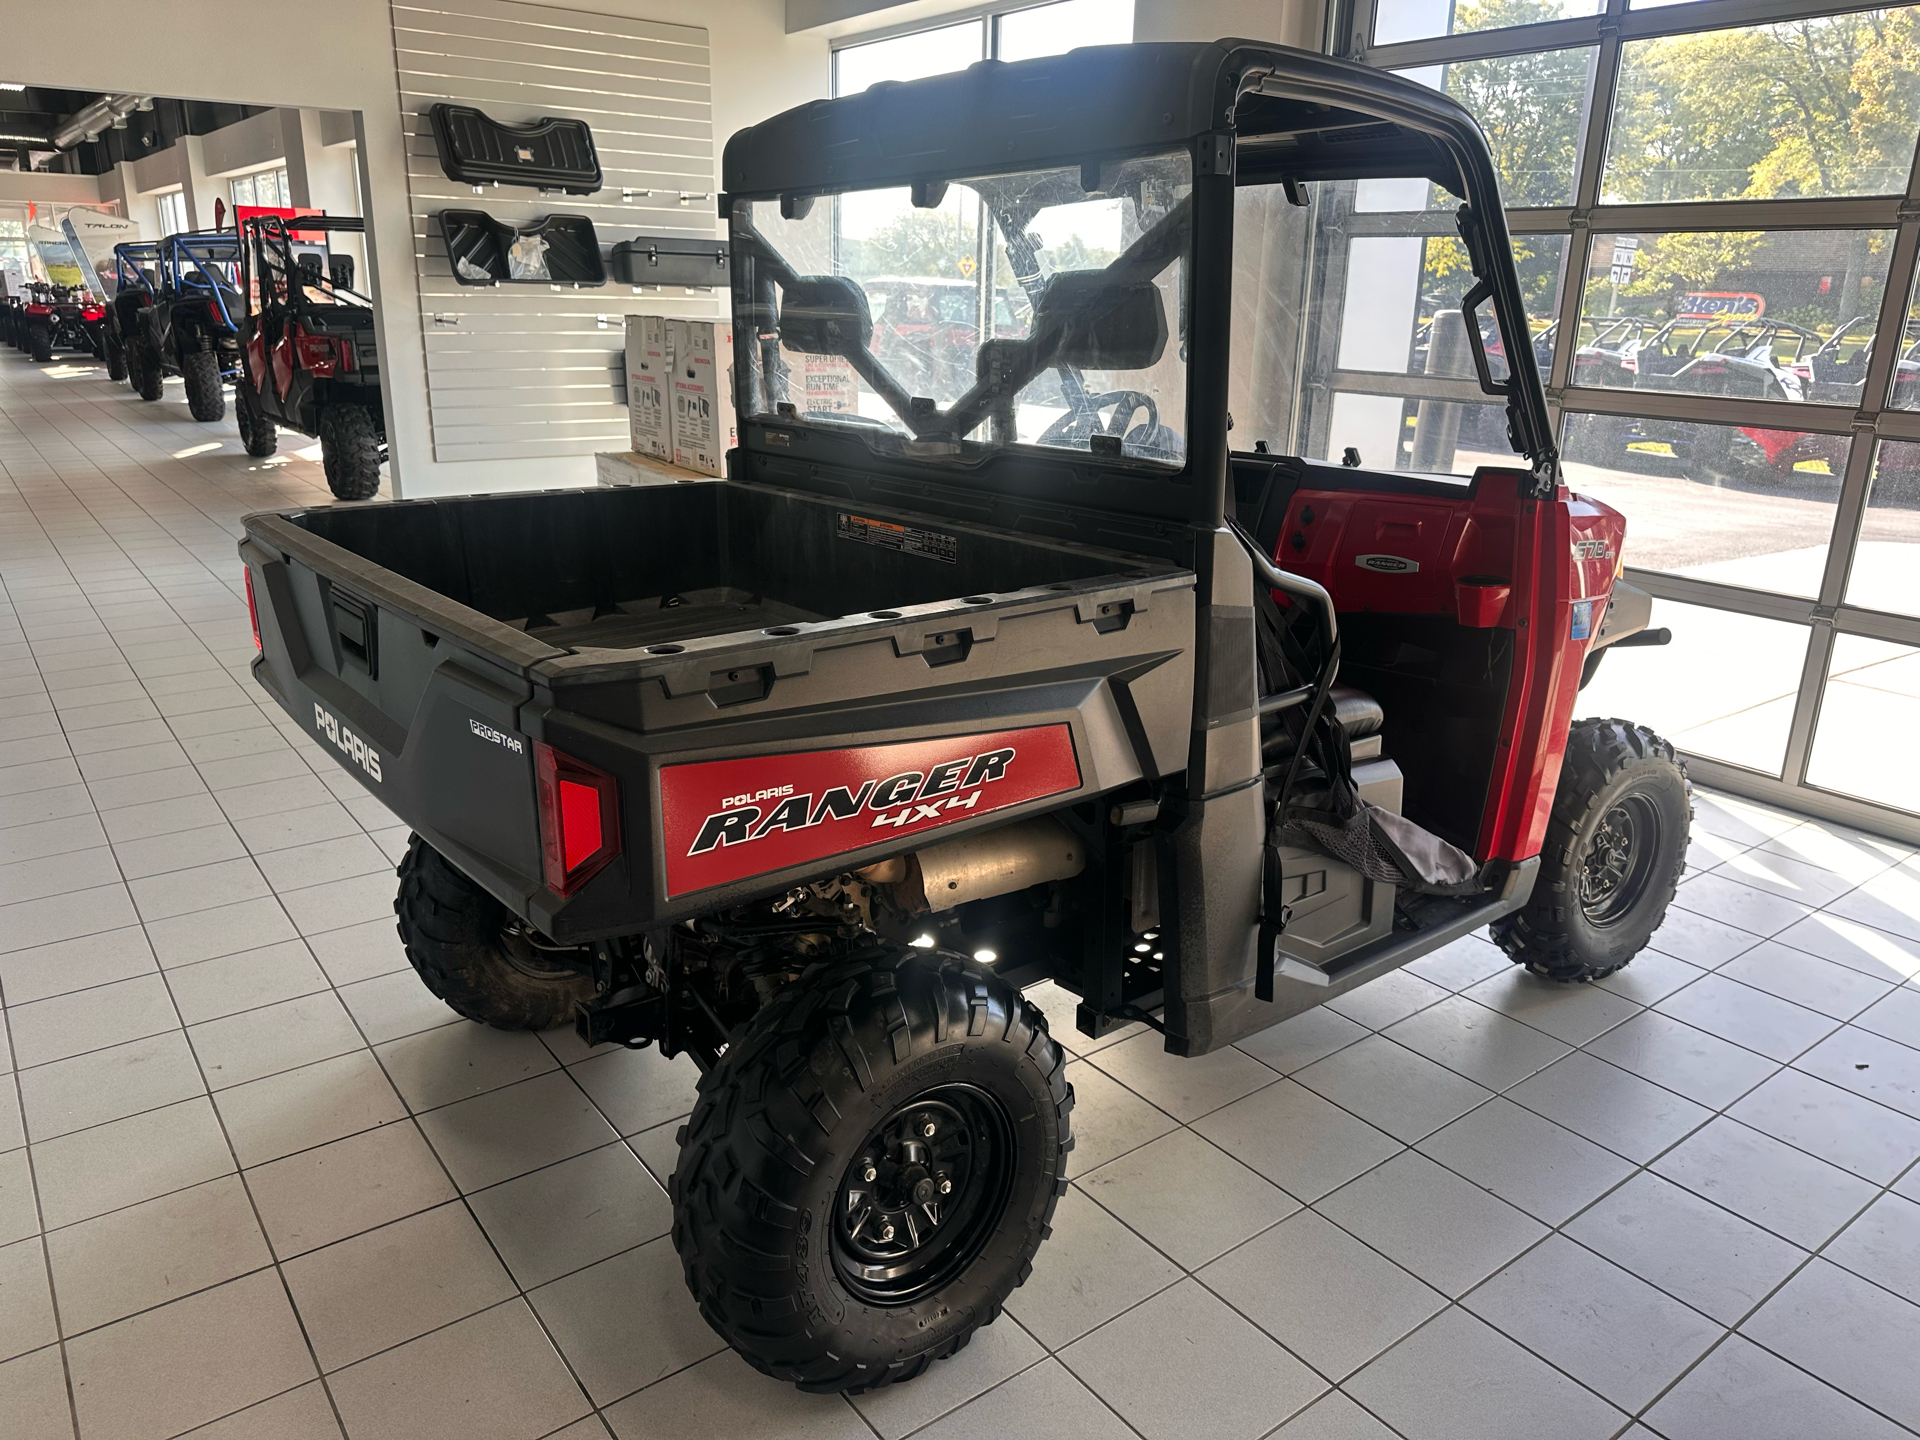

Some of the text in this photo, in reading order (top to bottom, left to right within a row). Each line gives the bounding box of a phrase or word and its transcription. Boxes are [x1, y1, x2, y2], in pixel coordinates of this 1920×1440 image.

[694, 357, 711, 365] HONDA
[805, 355, 828, 363] SUPER
[805, 375, 850, 383] EXCEPTIONAL
[805, 383, 839, 391] RUN TIME
[806, 398, 833, 406] ELECTRIC
[1573, 540, 1605, 561] 570
[1367, 560, 1406, 569] RANGER
[469, 718, 523, 754] PROSTAR
[314, 702, 383, 783] POLARIS
[721, 784, 794, 809] POLARIS
[687, 748, 1016, 856] RANGER
